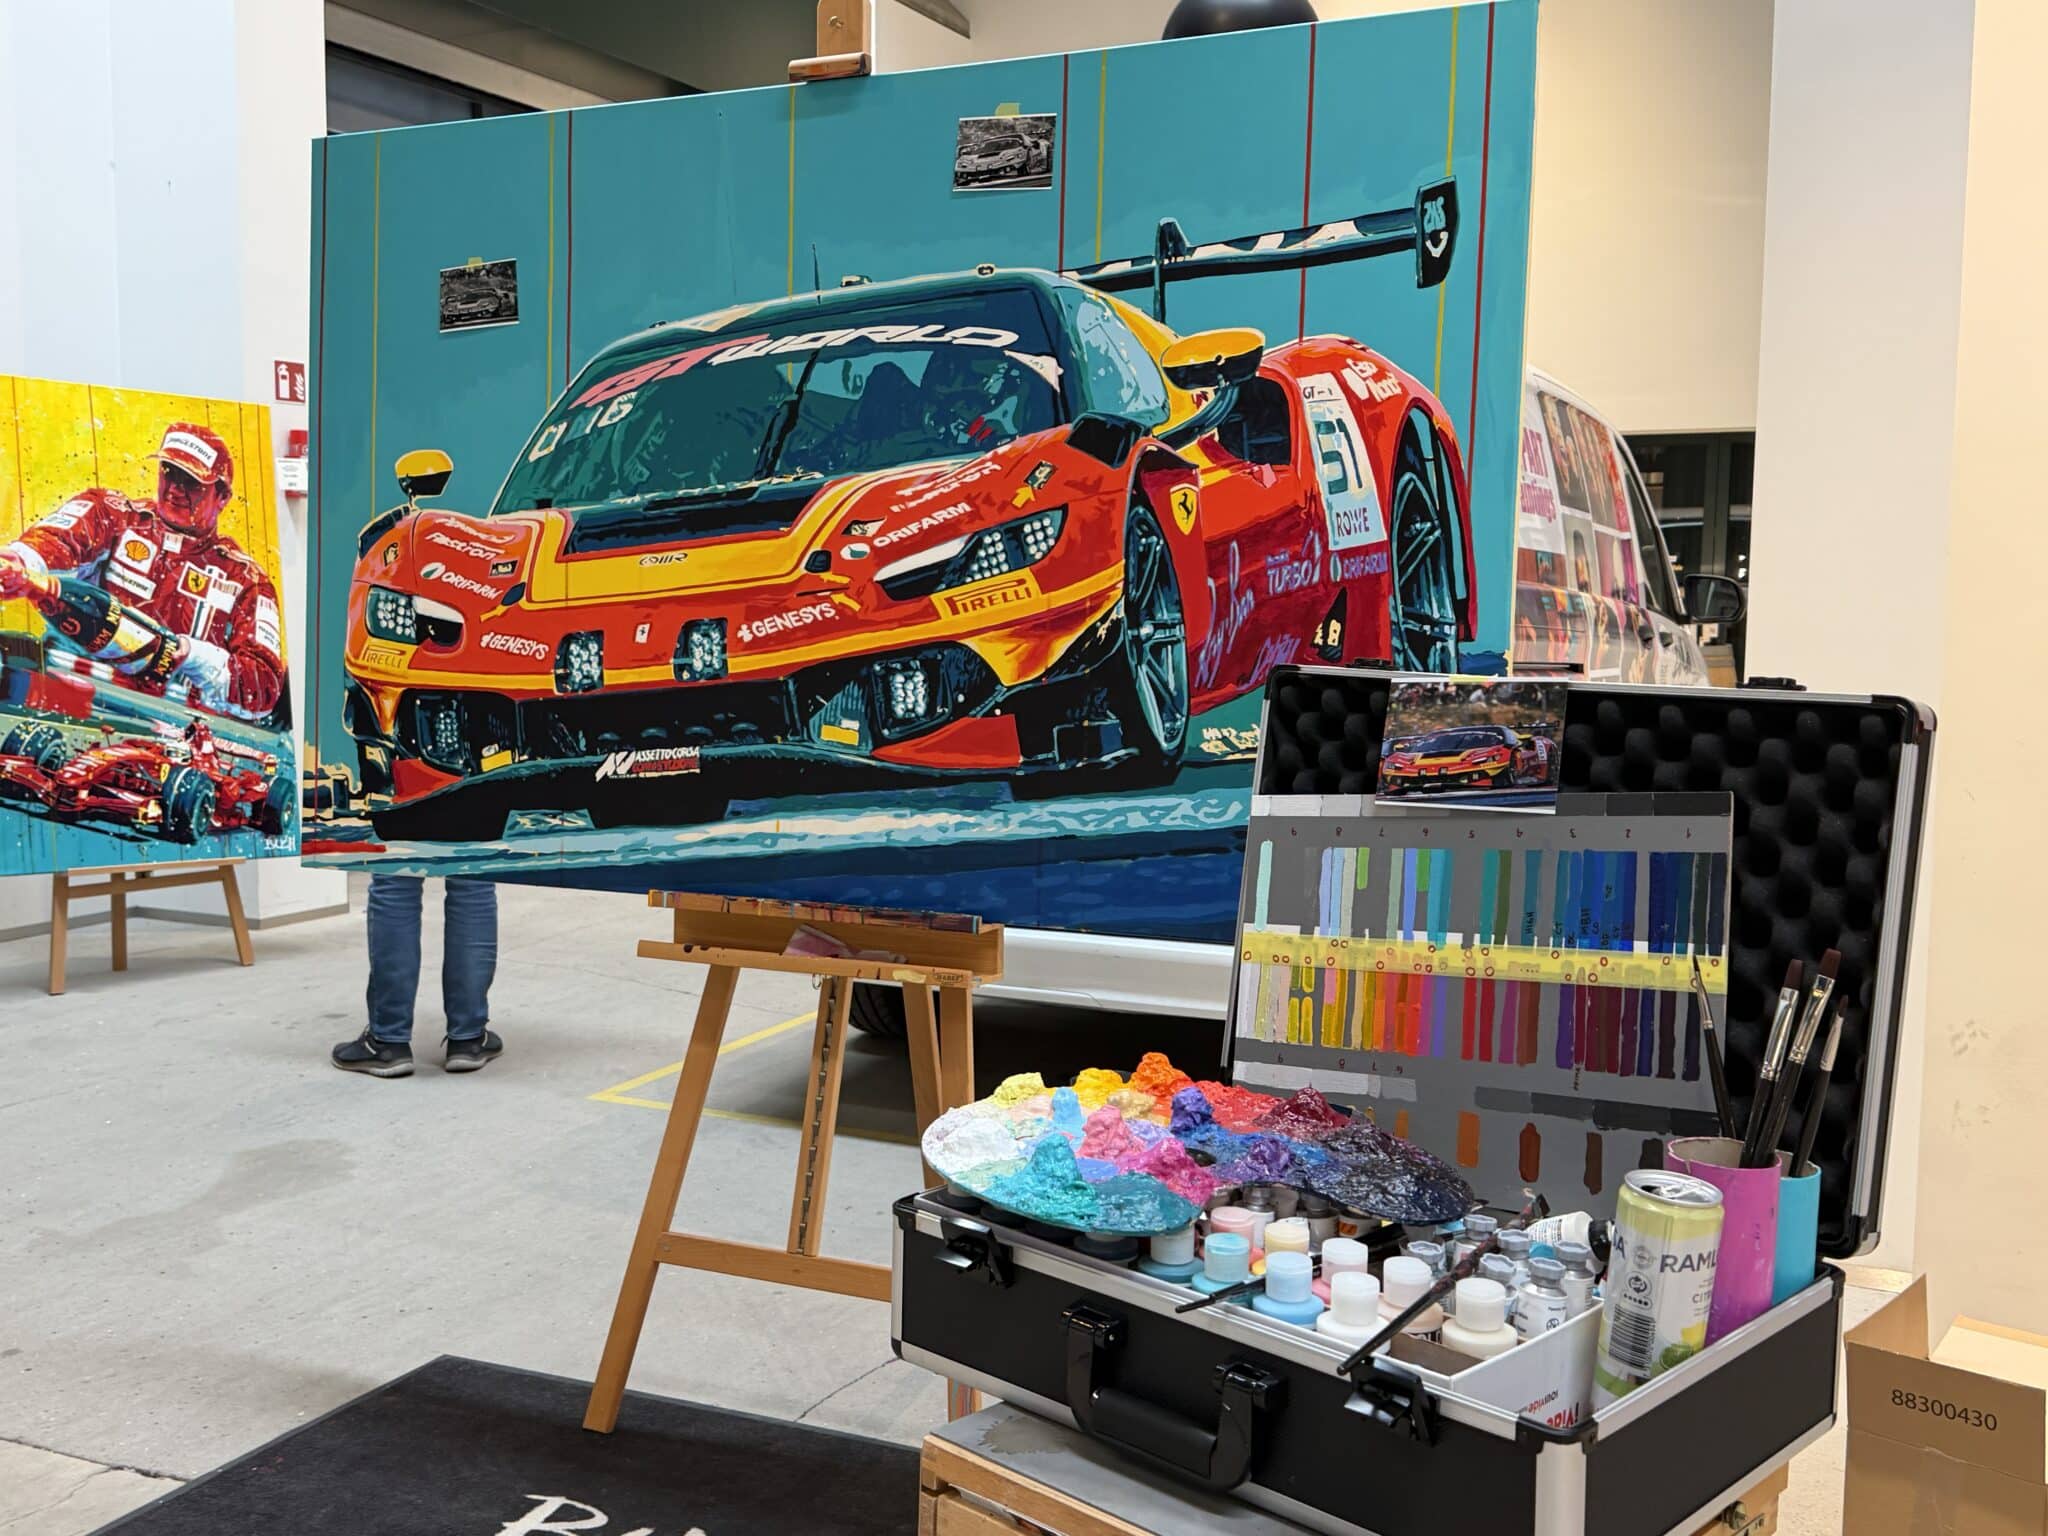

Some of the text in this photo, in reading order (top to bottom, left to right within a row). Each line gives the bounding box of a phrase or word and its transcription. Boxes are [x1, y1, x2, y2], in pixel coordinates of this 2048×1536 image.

[872, 501, 973, 549] ORIFARM
[1335, 507, 1371, 538] ROWE
[441, 569, 503, 601] ORIFARM
[1266, 560, 1313, 595] TURBO
[943, 578, 1032, 617] PIRELLI
[750, 601, 838, 639] GENESYS
[364, 644, 406, 670] PIRELLI
[491, 633, 551, 661] GENESYS
[1890, 1389, 1998, 1432] 88300430
